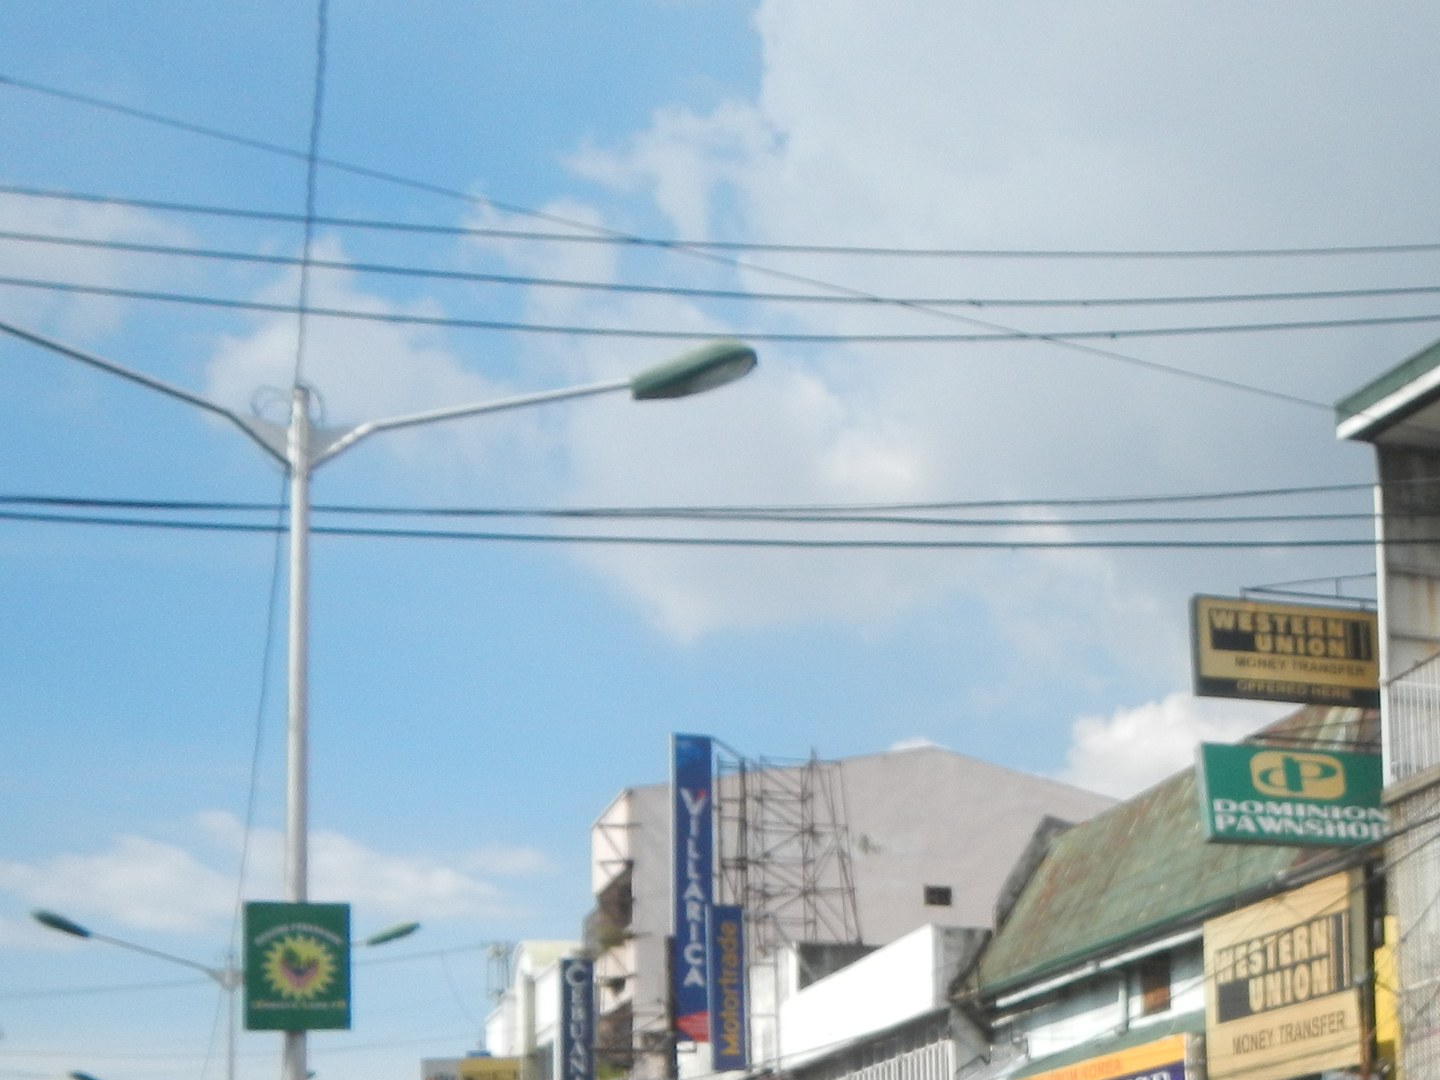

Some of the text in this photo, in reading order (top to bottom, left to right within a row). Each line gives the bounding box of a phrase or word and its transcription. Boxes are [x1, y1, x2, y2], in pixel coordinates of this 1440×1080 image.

[1209, 608, 1345, 638] WESTERN
[1254, 631, 1346, 659] UNION
[1234, 656, 1376, 676] MONEY TRANSFER
[1212, 798, 1388, 822] DOMINION
[1214, 813, 1390, 841] PAWNSHOP
[680, 787, 707, 987] VILLARICA
[1214, 917, 1329, 983] WESTERN
[717, 920, 741, 1057] Motortrade
[1249, 956, 1330, 1012] UNION
[1232, 1009, 1347, 1055] MONEY TRANSFER
